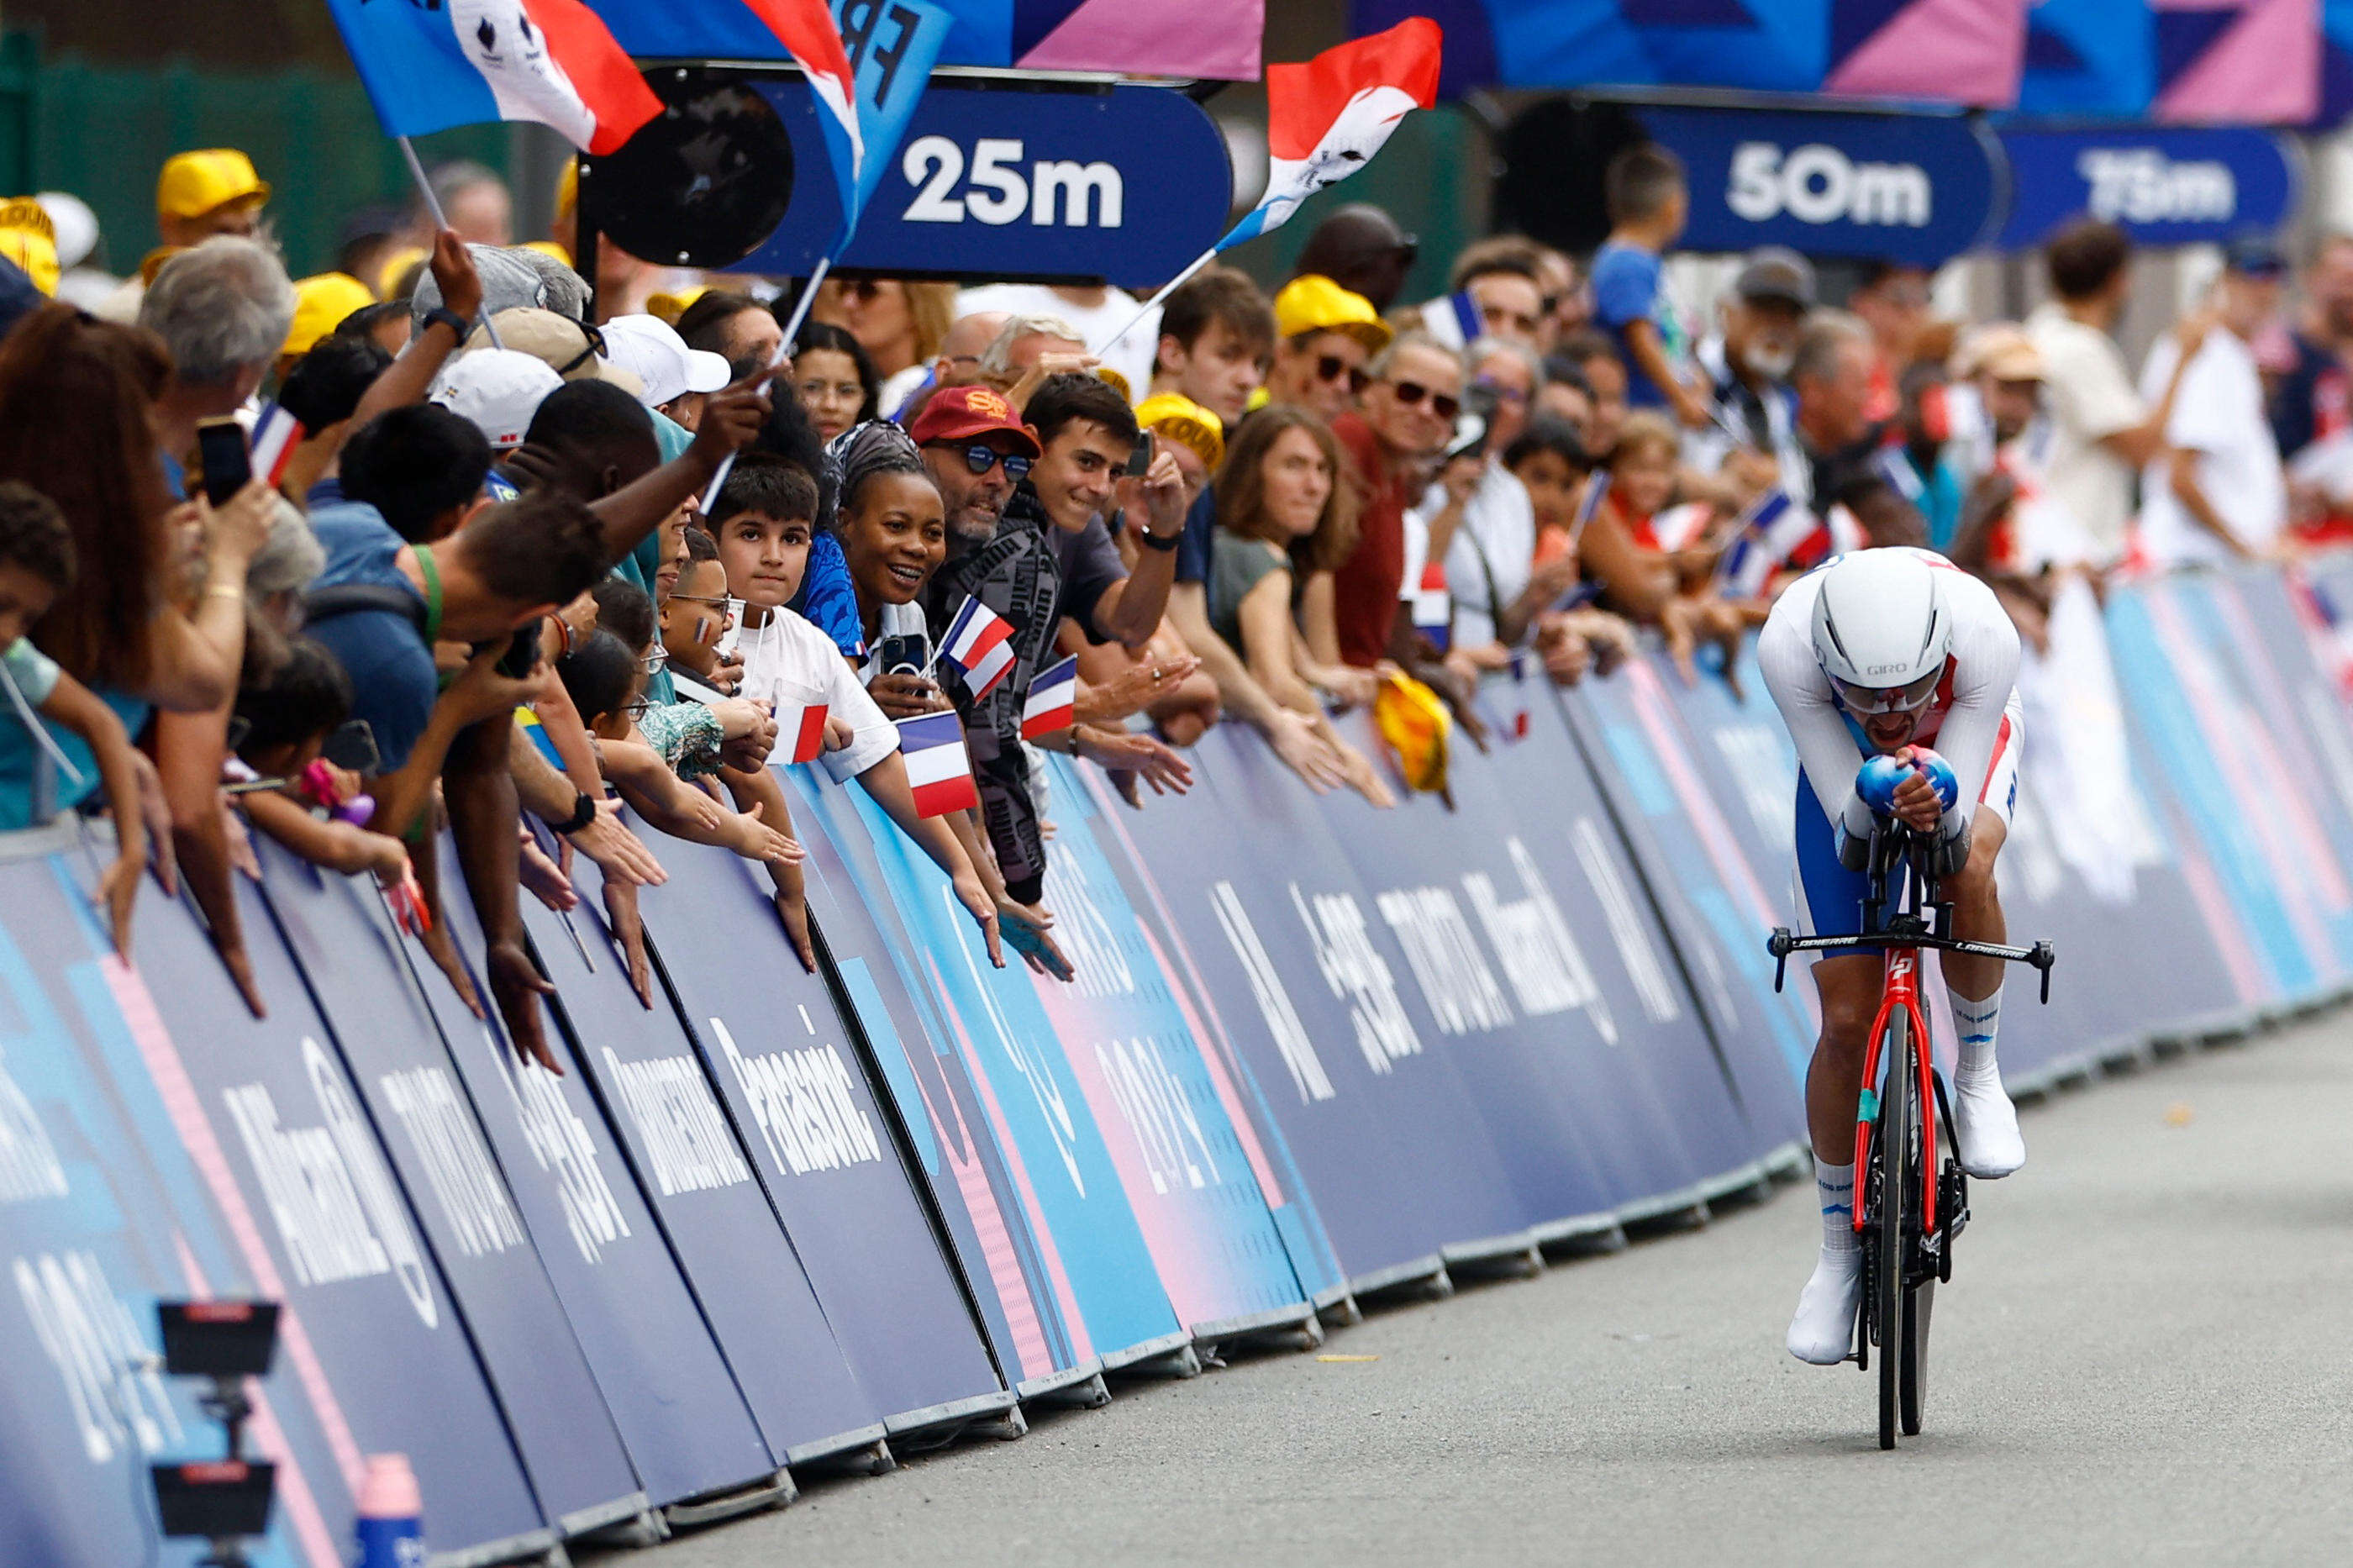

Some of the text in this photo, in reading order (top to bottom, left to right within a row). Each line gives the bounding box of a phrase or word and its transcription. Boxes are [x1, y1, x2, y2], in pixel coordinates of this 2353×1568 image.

[902, 134, 1124, 229] 25m
[1725, 142, 1932, 229] 50m
[1866, 662, 1908, 676] GIRO
[1792, 935, 1860, 949] LAPIERRE
[1955, 941, 2029, 960] LAPIERRE
[708, 1003, 882, 1177] Panasonic
[1094, 1026, 1221, 1196] 2024
